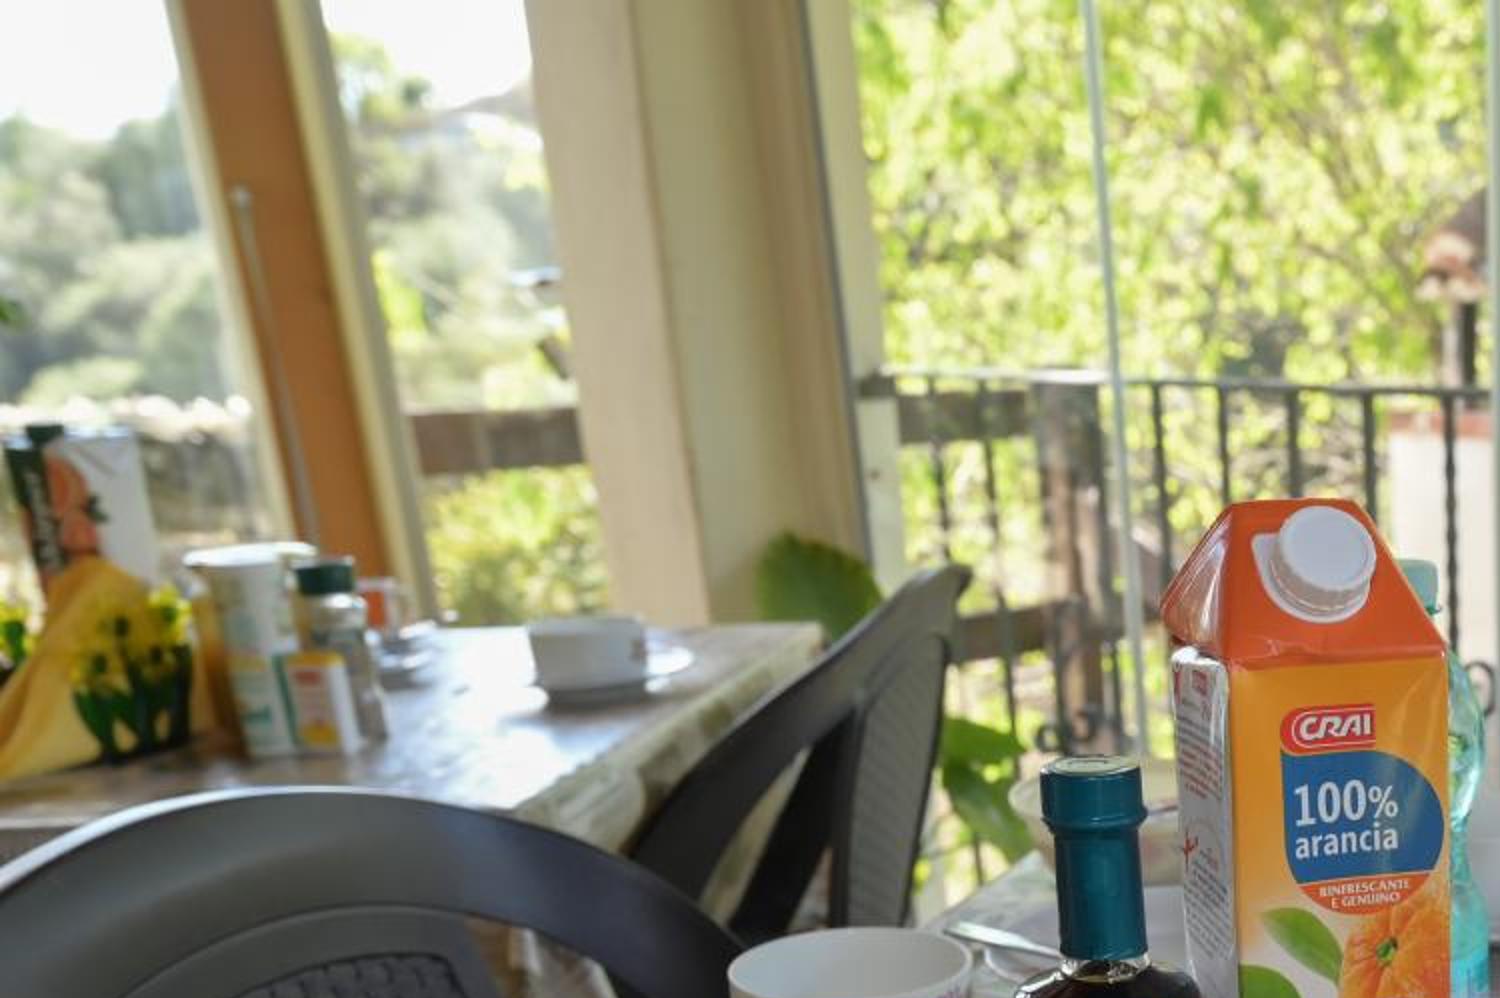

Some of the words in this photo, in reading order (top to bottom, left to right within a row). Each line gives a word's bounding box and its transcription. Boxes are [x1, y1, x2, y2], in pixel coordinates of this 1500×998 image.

[1300, 714, 1371, 740] CRAI
[1294, 780, 1398, 826] 100%
[1296, 822, 1398, 859] arancia
[1320, 879, 1408, 896] RINFRESCANTE
[1342, 891, 1400, 906] GENUINO
